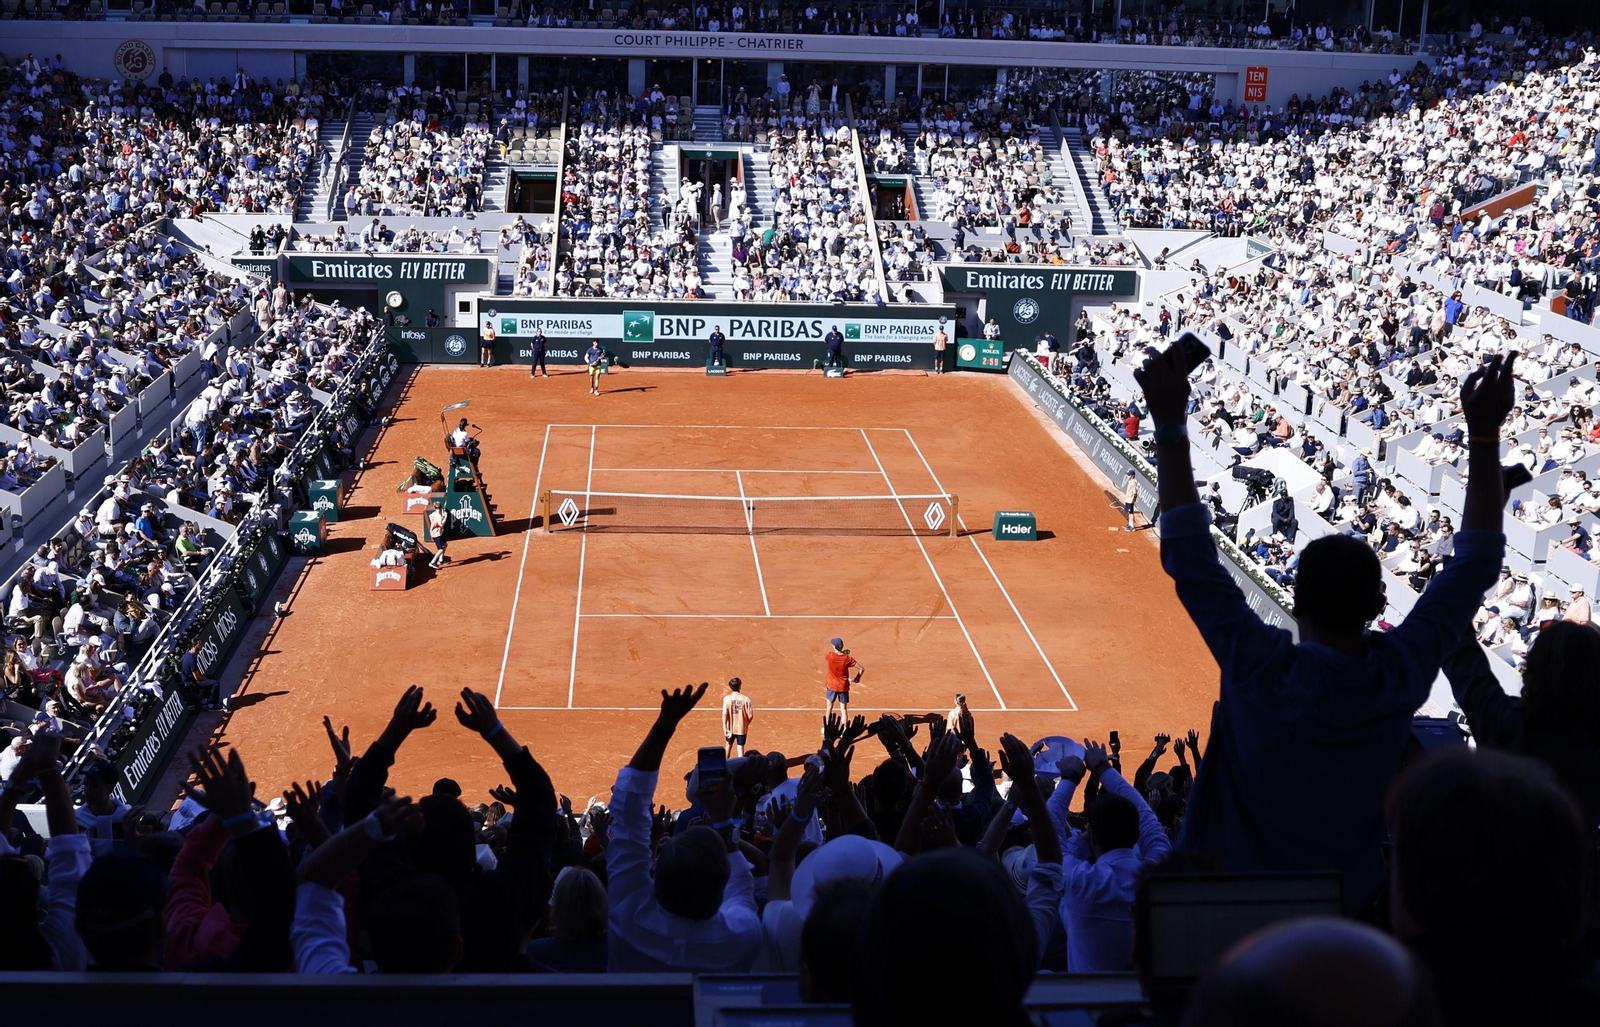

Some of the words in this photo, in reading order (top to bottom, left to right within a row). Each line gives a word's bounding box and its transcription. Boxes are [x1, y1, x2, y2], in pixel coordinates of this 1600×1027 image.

[614, 34, 661, 46] COURT
[665, 35, 725, 47] PHILIPPE
[737, 37, 804, 50] CHATRIER
[1249, 71, 1265, 81] TEN
[1248, 87, 1263, 98] NIS
[311, 260, 393, 279] Emirates
[400, 261, 419, 279] FLY
[423, 262, 466, 280] BETTER
[966, 271, 1044, 289] Emirates
[1050, 273, 1069, 290] FLY
[1073, 273, 1115, 291] BETTER
[521, 319, 544, 329] BNP
[546, 319, 593, 330] PARIBAS
[660, 318, 706, 337] BNP
[729, 319, 823, 338] PARIBAS
[864, 324, 887, 334] BNP
[889, 325, 935, 335] PARIBAS
[401, 330, 426, 340] Infosys
[544, 349, 578, 358] ARIBAS
[632, 350, 651, 359] BNP
[652, 351, 690, 360] PARIBAS
[743, 352, 762, 361] BNP
[763, 352, 801, 361] PARIBAS
[854, 354, 874, 362] BNP
[875, 354, 912, 363] PARIBAS
[1037, 387, 1059, 413] LACOSTE
[1073, 421, 1094, 446] RENAULT
[1099, 447, 1123, 475] RENAULT
[1136, 481, 1158, 509] ENAULT
[1002, 523, 1032, 535] Haier
[393, 530, 415, 543] HEAD
[196, 635, 219, 675] nfosys
[123, 731, 161, 790] Emirates
[162, 690, 185, 729] BETTER
